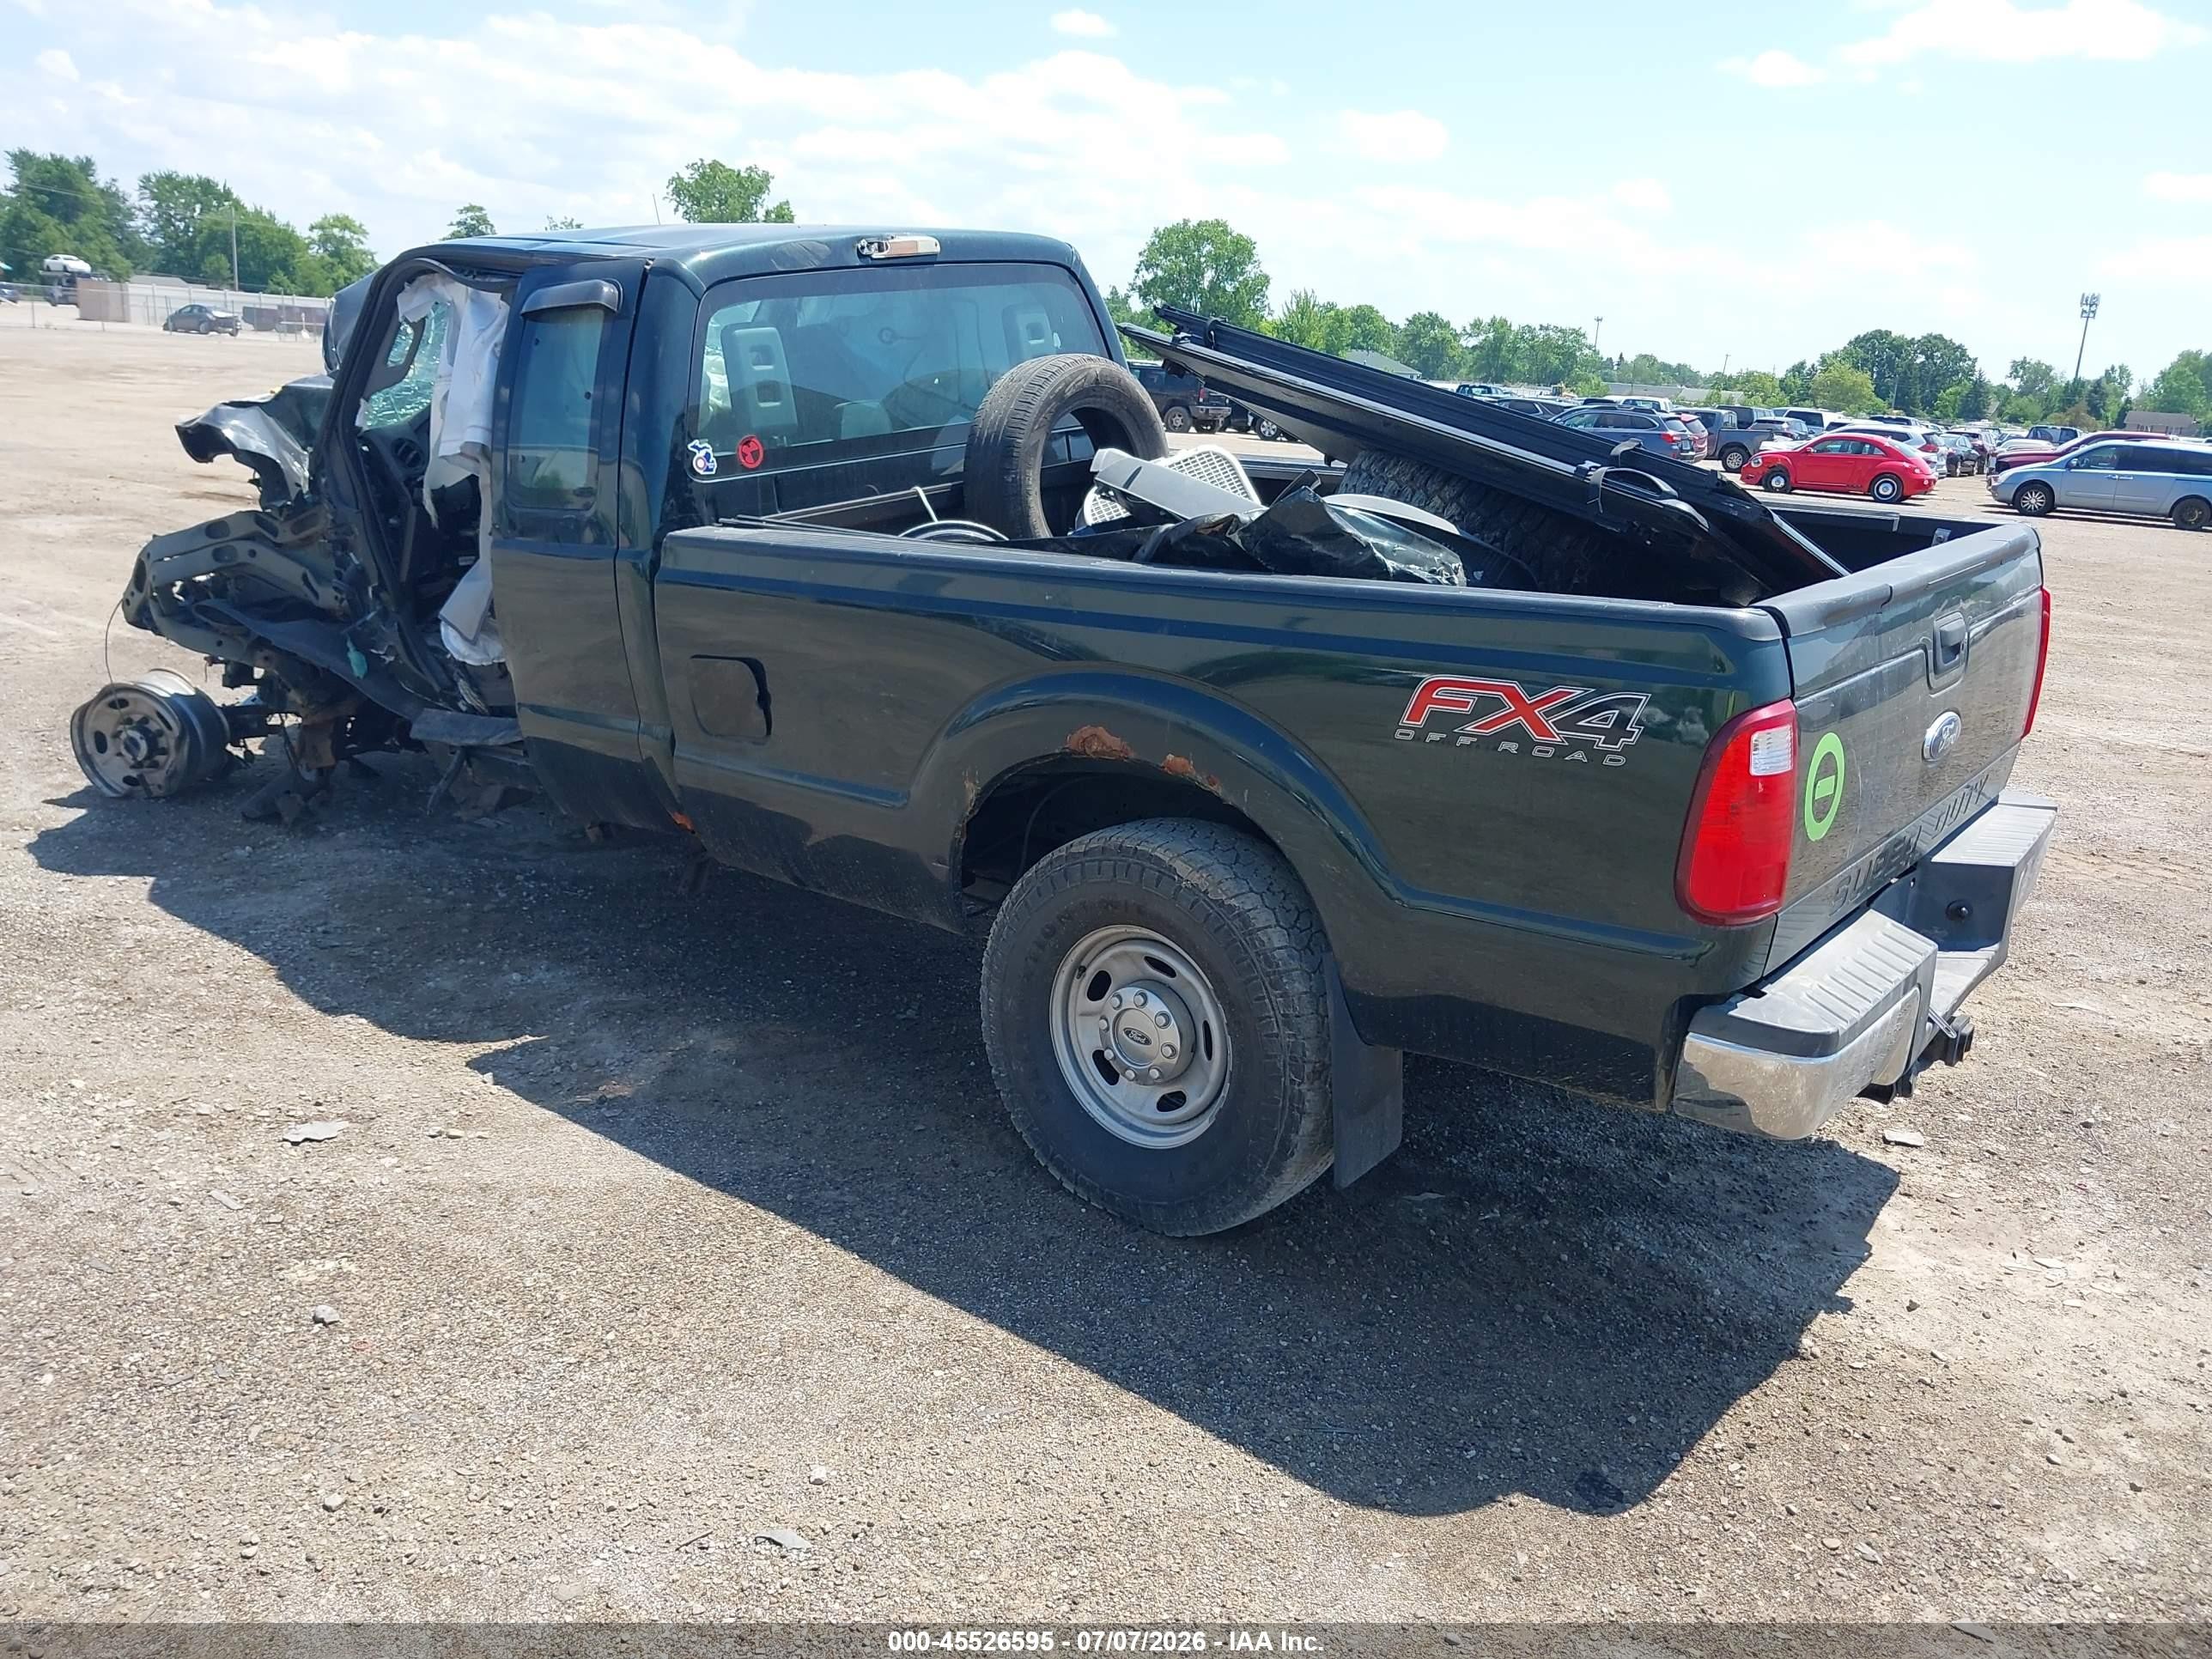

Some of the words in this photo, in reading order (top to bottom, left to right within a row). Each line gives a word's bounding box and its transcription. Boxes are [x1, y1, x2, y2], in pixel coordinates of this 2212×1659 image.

[1398, 674, 1653, 753] FX4
[1394, 728, 1478, 747] OFF
[1497, 741, 1627, 768] ROAD
[1932, 774, 1990, 839] DUTY
